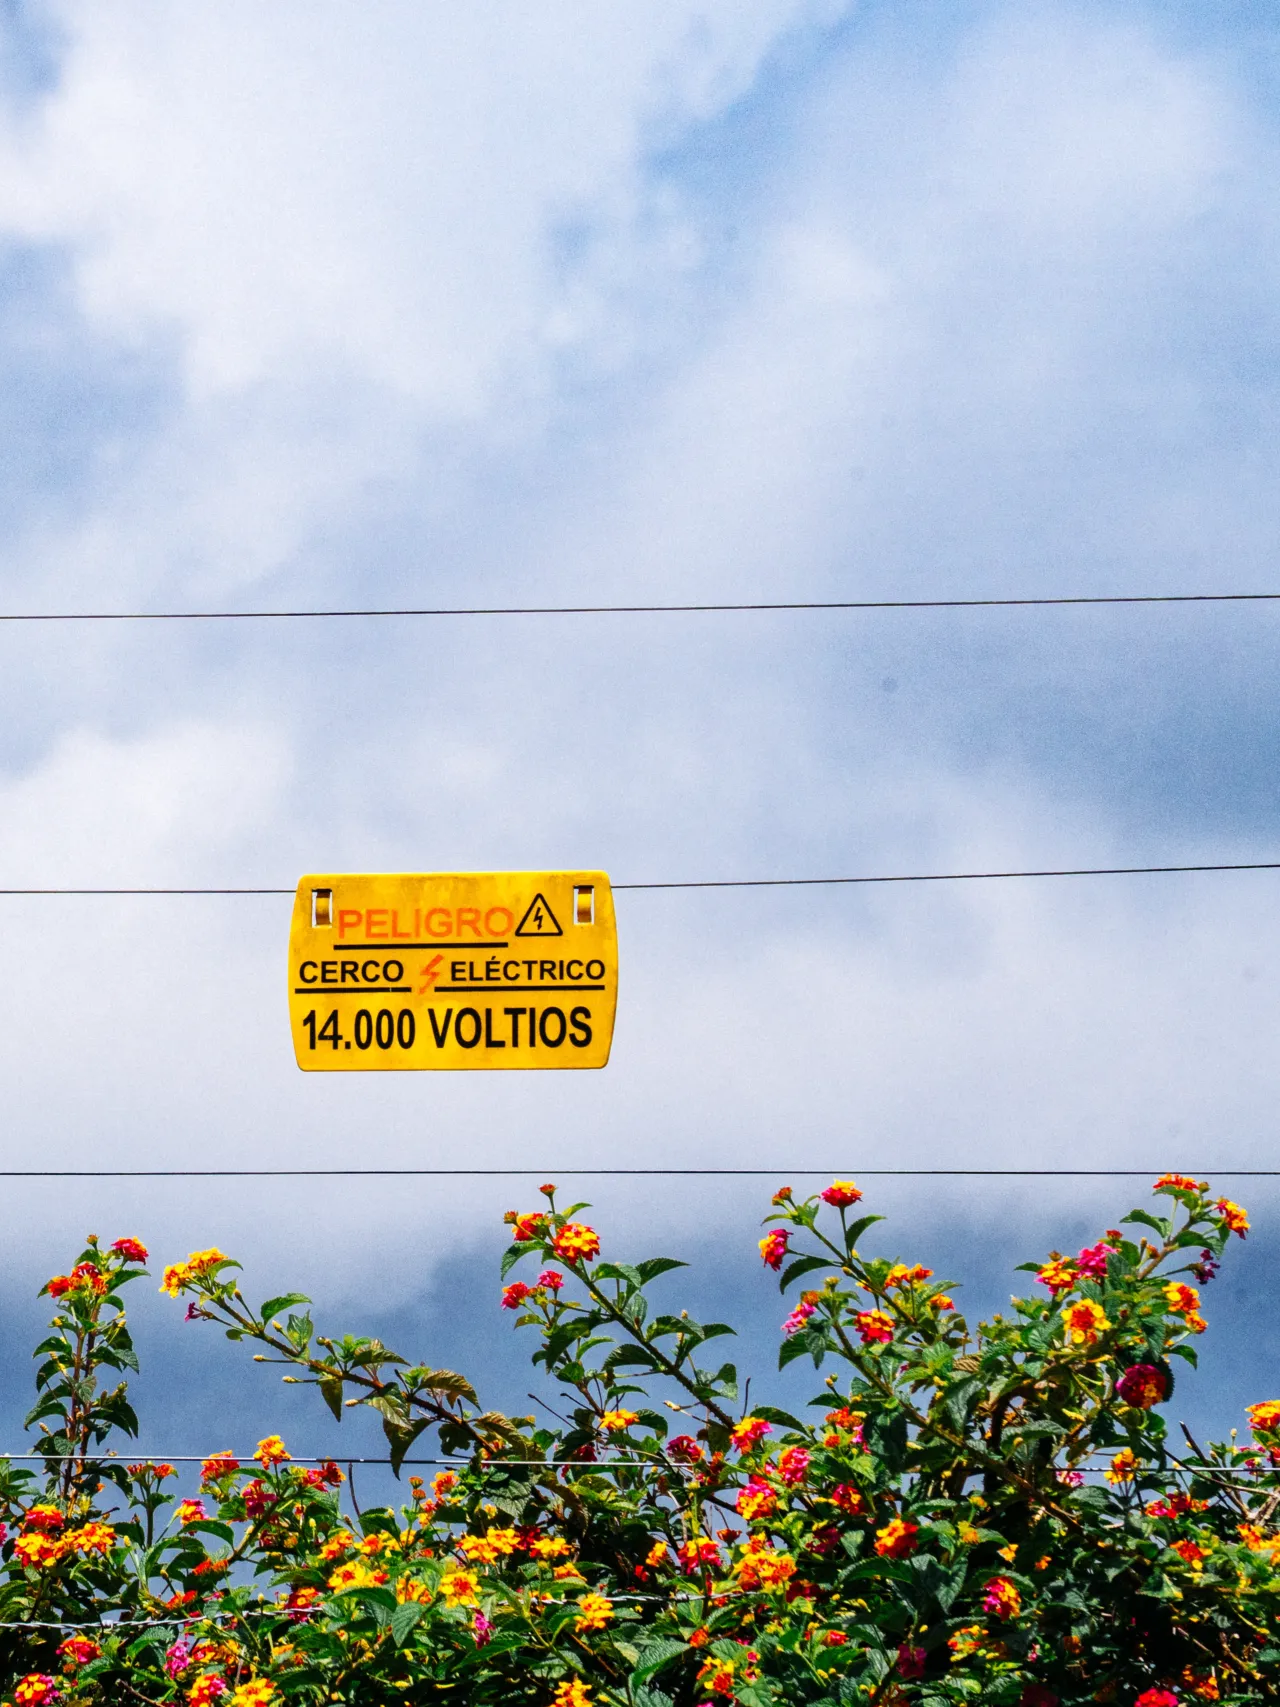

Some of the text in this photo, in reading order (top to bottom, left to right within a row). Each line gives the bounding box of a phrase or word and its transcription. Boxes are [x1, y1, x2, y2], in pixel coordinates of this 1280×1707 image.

[338, 906, 514, 939] PELIGRO
[299, 955, 606, 983] CERCO ELÉCTRICO
[302, 1006, 593, 1050] 14.000 VOLTIOS
